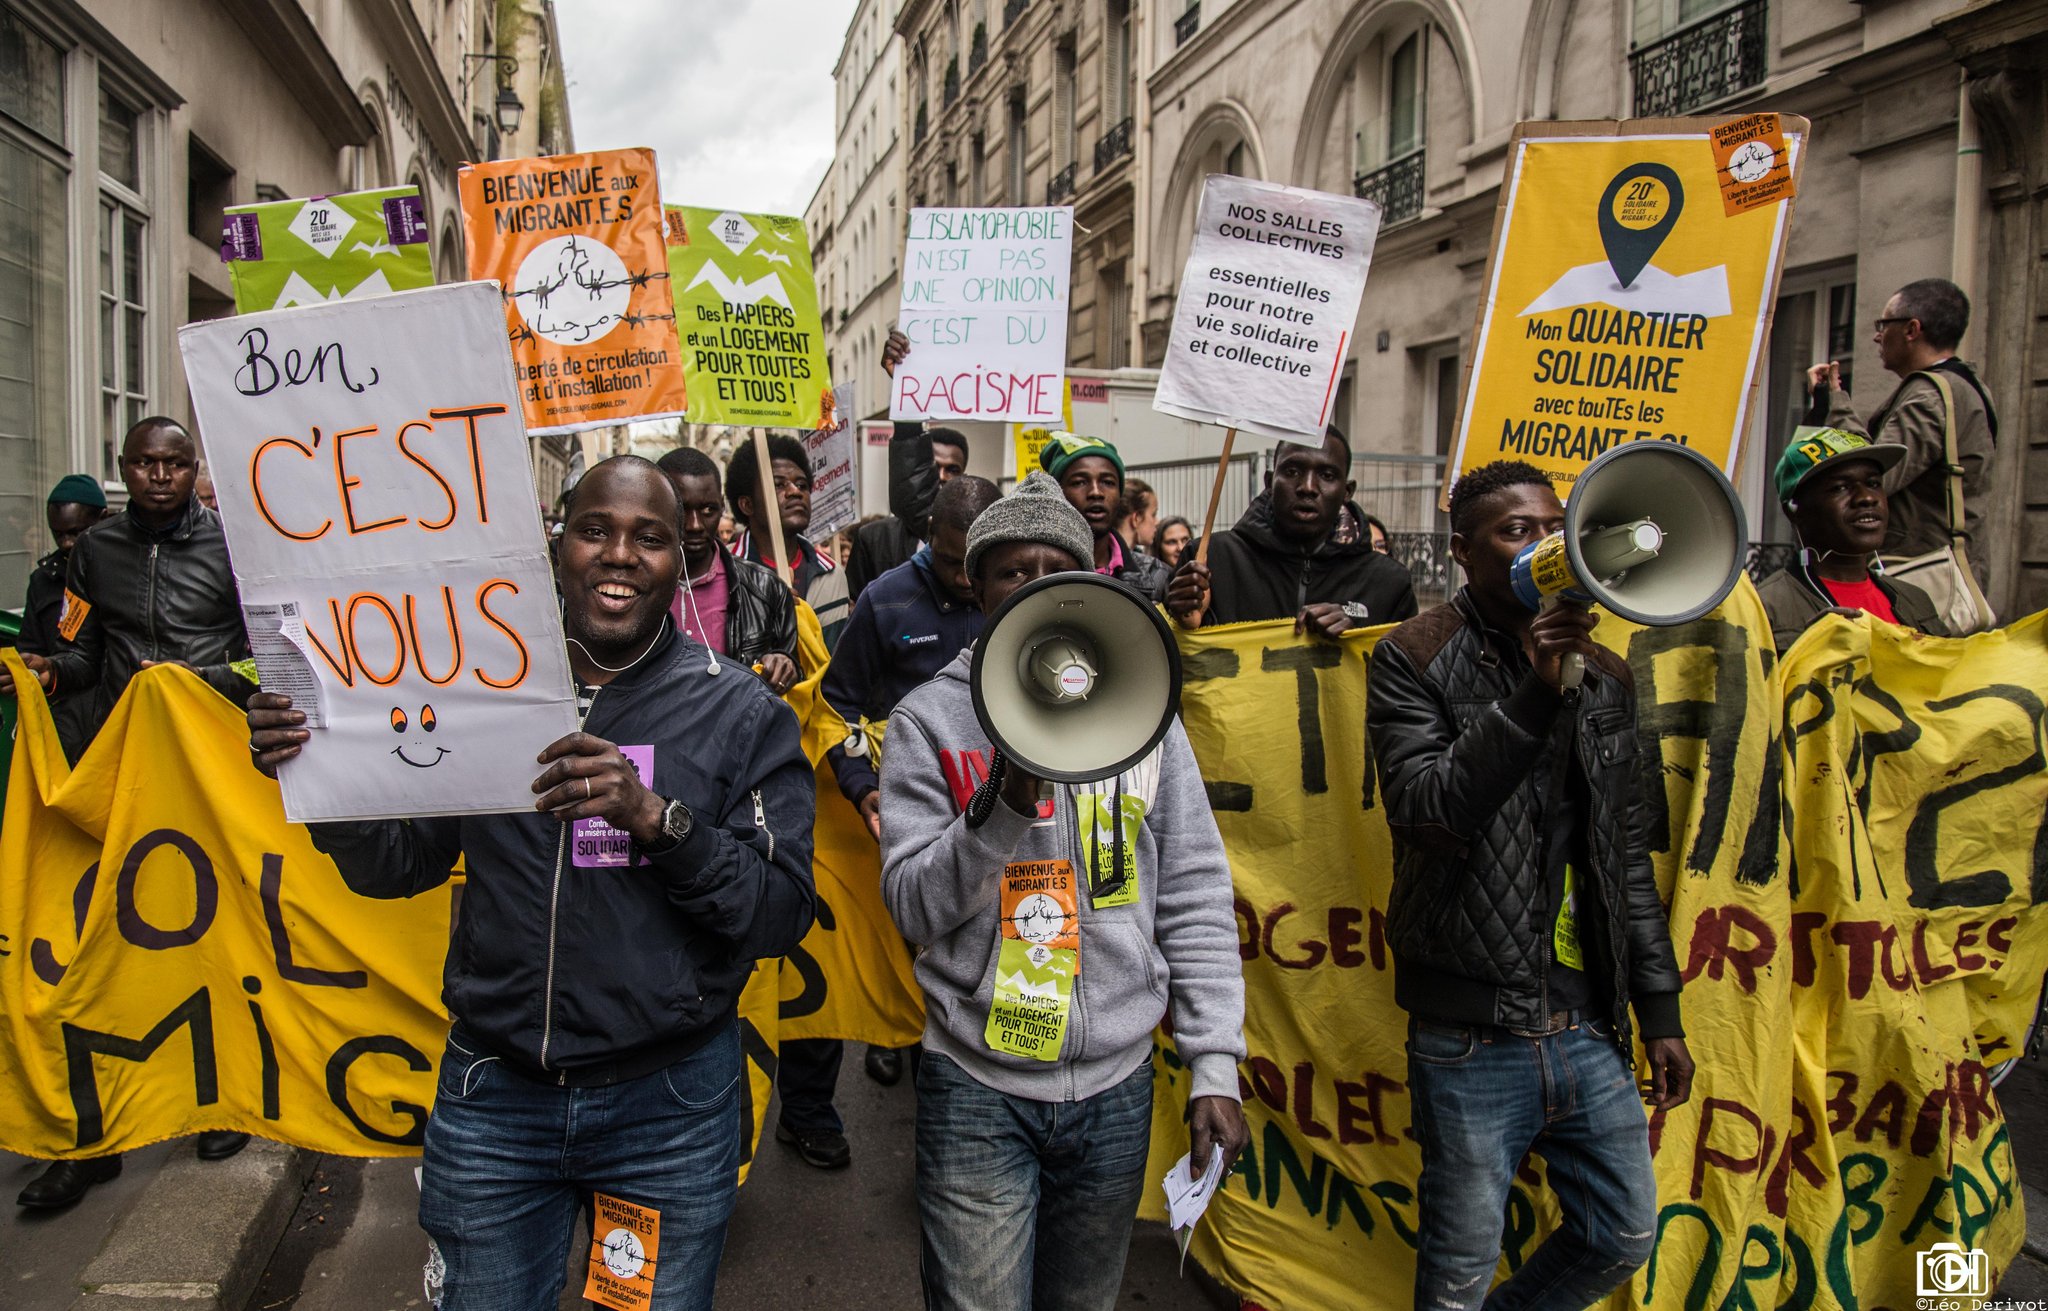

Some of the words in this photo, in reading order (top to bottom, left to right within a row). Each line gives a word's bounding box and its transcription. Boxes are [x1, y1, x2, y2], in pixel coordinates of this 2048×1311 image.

[1714, 114, 1761, 139] BIENVENUE
[482, 166, 606, 205] BIENVENUE
[610, 175, 639, 191] aux
[494, 195, 633, 235] MIGRANT.E.S
[1623, 200, 1659, 208] SOLIDAIRE
[311, 224, 337, 233] SOLIDAIRE
[908, 210, 1067, 240] L'ISLAMOPHOBIE
[1227, 203, 1267, 224] NOS
[1271, 212, 1343, 238] SALLES
[1218, 223, 1344, 260] COLLECTIVES
[917, 248, 971, 271] N'EST
[999, 247, 1047, 271] PAS
[902, 278, 946, 304] UNE
[962, 275, 1055, 303] OPINION
[1209, 266, 1331, 303] essentielles
[696, 304, 721, 322] Des
[723, 301, 796, 329] PAPIERS
[1205, 291, 1255, 313] pour
[1259, 300, 1315, 326] notre
[687, 331, 700, 347] et
[702, 335, 719, 348] un
[720, 326, 810, 355] LOGEMENT
[906, 316, 978, 345] C'EST
[1007, 315, 1047, 345] DU
[1195, 314, 1225, 332] vie
[1230, 321, 1320, 354] solidaire
[1526, 318, 1563, 341] Mon
[1567, 307, 1708, 351] QUARTIER
[563, 356, 582, 379] de
[586, 349, 668, 374] circulation
[695, 350, 745, 376] POUR
[745, 353, 811, 379] TOUTES
[1189, 339, 1209, 355] et
[1214, 342, 1312, 378] collective
[1533, 349, 1684, 393] SOLIDAIRE
[525, 385, 540, 402] et
[544, 373, 642, 401] d'installation
[645, 368, 652, 388] !
[717, 377, 737, 401] ET
[740, 378, 787, 404] TOUS
[790, 382, 797, 404] !
[1533, 396, 1575, 416] avec
[1577, 396, 1635, 420] touTEs
[1637, 400, 1665, 424] les
[249, 402, 510, 544] C'EST
[817, 455, 827, 470] au
[577, 829, 584, 837] la
[584, 828, 607, 837] misère
[607, 828, 614, 836] et
[614, 828, 621, 836] le
[1004, 863, 1056, 879] BIENVENUE
[1057, 866, 1070, 875] aux
[1002, 1008, 1012, 1017] un
[1013, 1006, 1064, 1027] LOGEMENT
[1005, 993, 1018, 1004] Des
[1020, 993, 1059, 1012] PAPIERS
[994, 1015, 1022, 1032] POUR
[1024, 1020, 1058, 1040] TOUTES
[1001, 1030, 1014, 1044] ET
[1015, 1033, 1040, 1051] TOUS
[1040, 1040, 1045, 1052] !
[599, 1195, 643, 1221] BIENVENUE
[644, 1215, 656, 1224] aux
[611, 1278, 619, 1288] de
[619, 1282, 650, 1300] circulation
